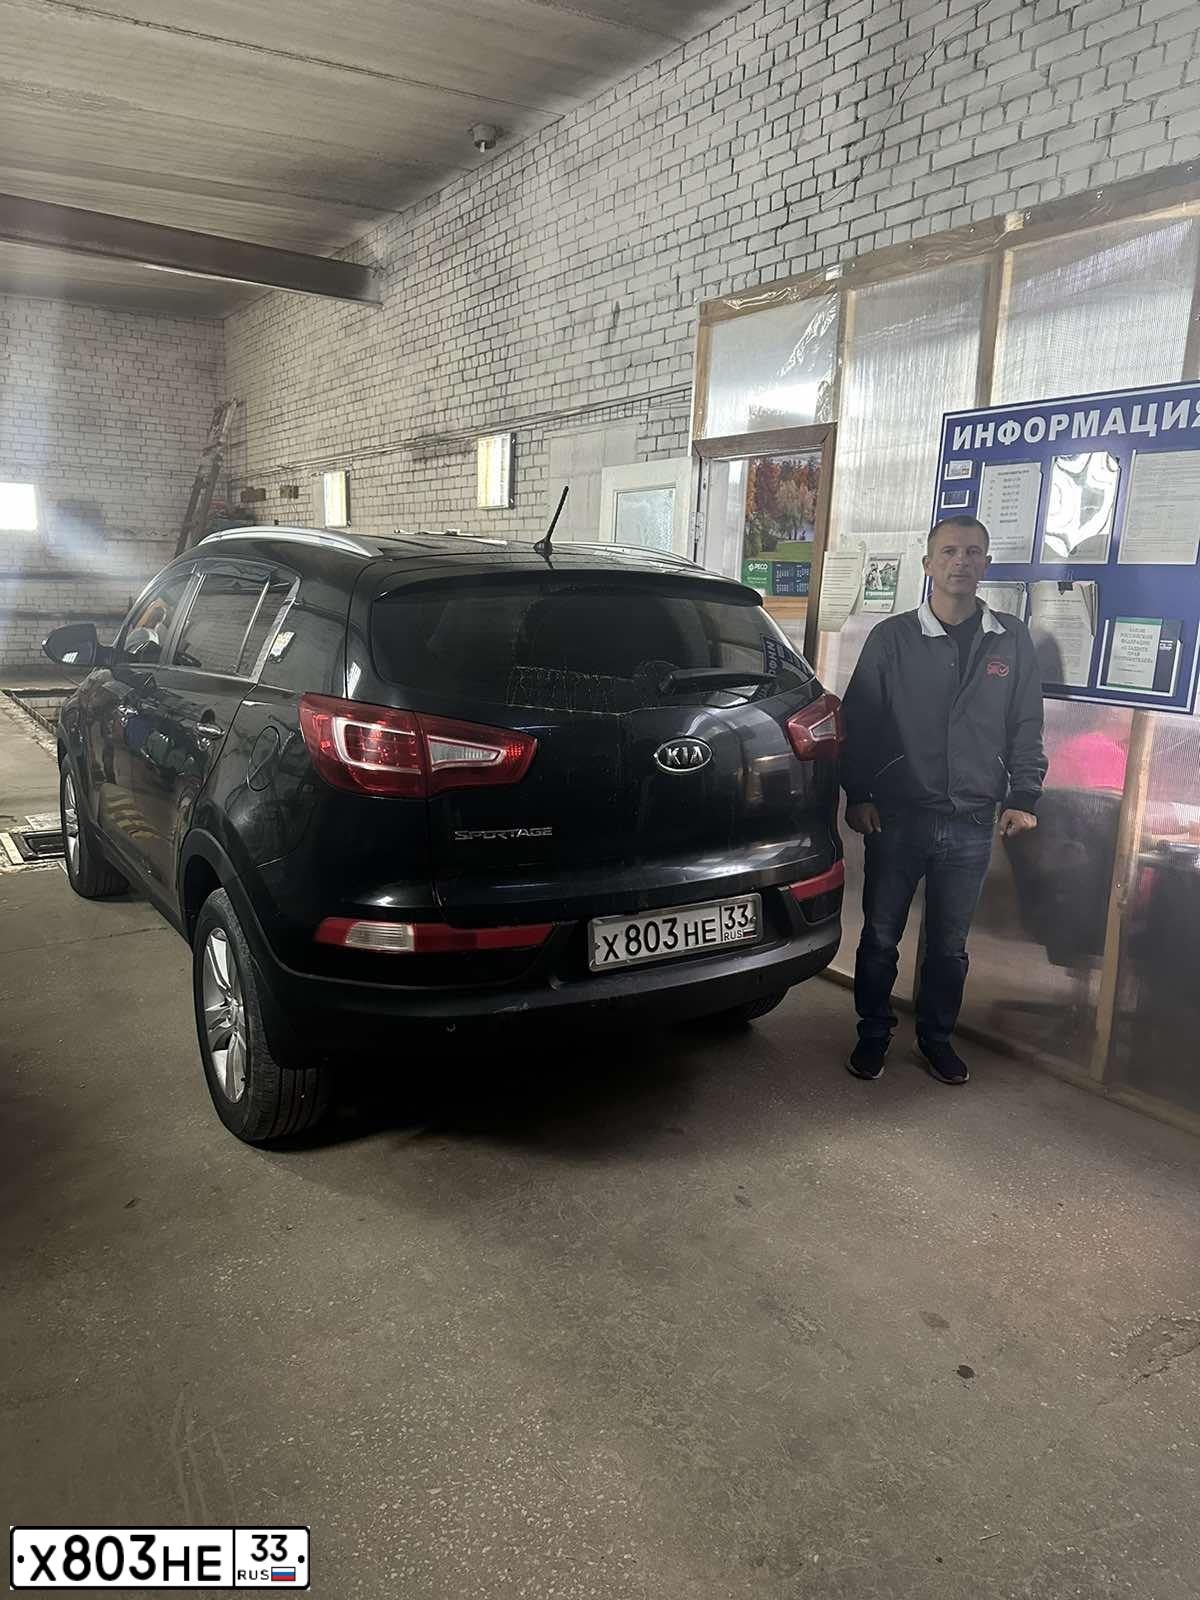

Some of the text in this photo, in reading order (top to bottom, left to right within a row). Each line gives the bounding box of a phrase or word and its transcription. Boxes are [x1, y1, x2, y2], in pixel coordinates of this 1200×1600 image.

[952, 399, 1200, 451] ИНФОРМАЦИ
[665, 744, 705, 767] KIA
[454, 826, 553, 841] SPORTAGE
[723, 904, 750, 931] 33
[723, 930, 743, 942] RUS
